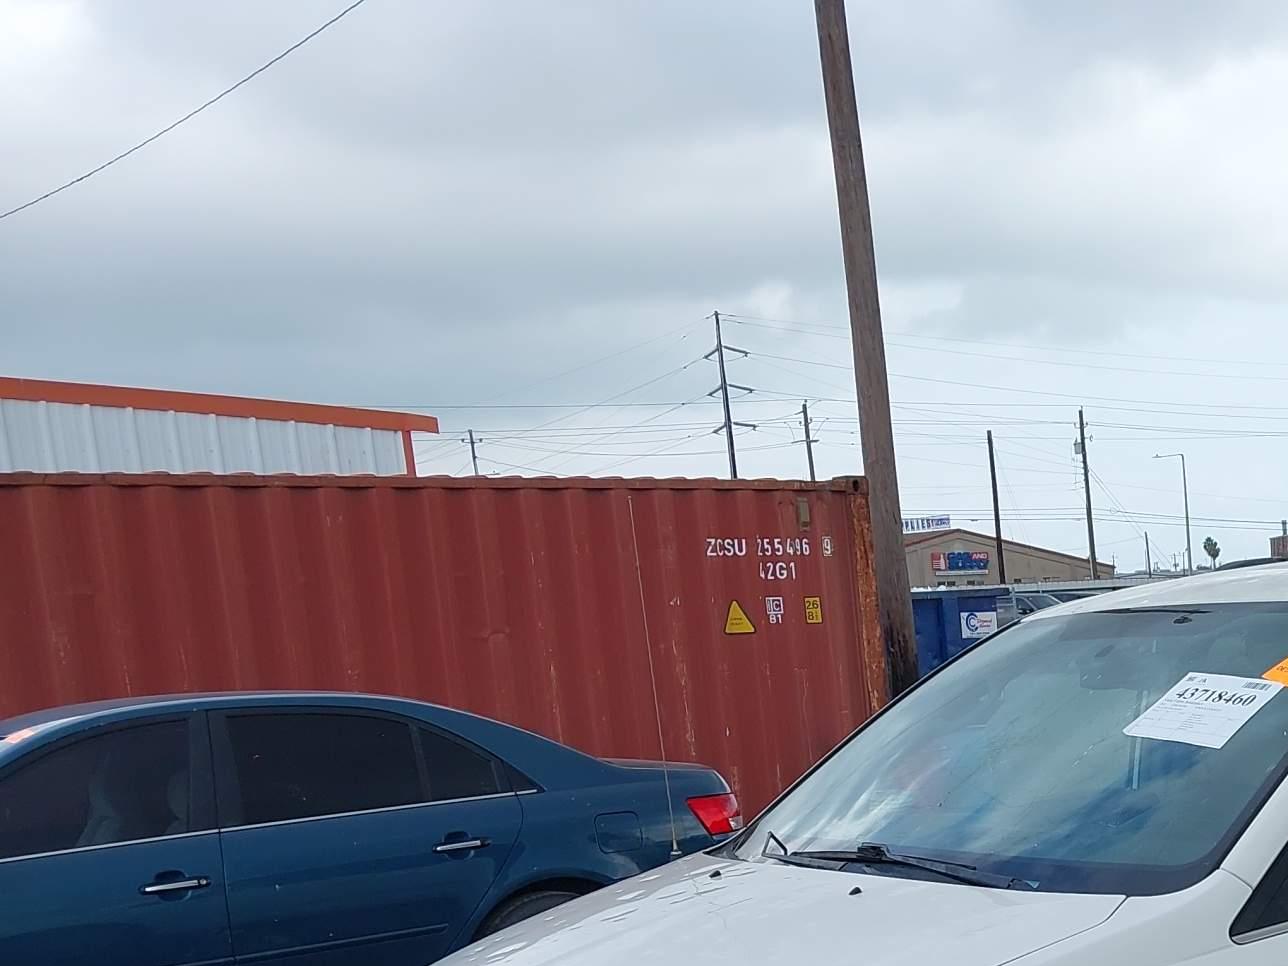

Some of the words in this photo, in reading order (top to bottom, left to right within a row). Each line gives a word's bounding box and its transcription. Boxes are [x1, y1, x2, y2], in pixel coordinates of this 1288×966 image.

[705, 538, 746, 556] ZCSU
[757, 537, 810, 556] 255496
[759, 562, 796, 580] 42G1
[1176, 687, 1257, 706] 43718460
